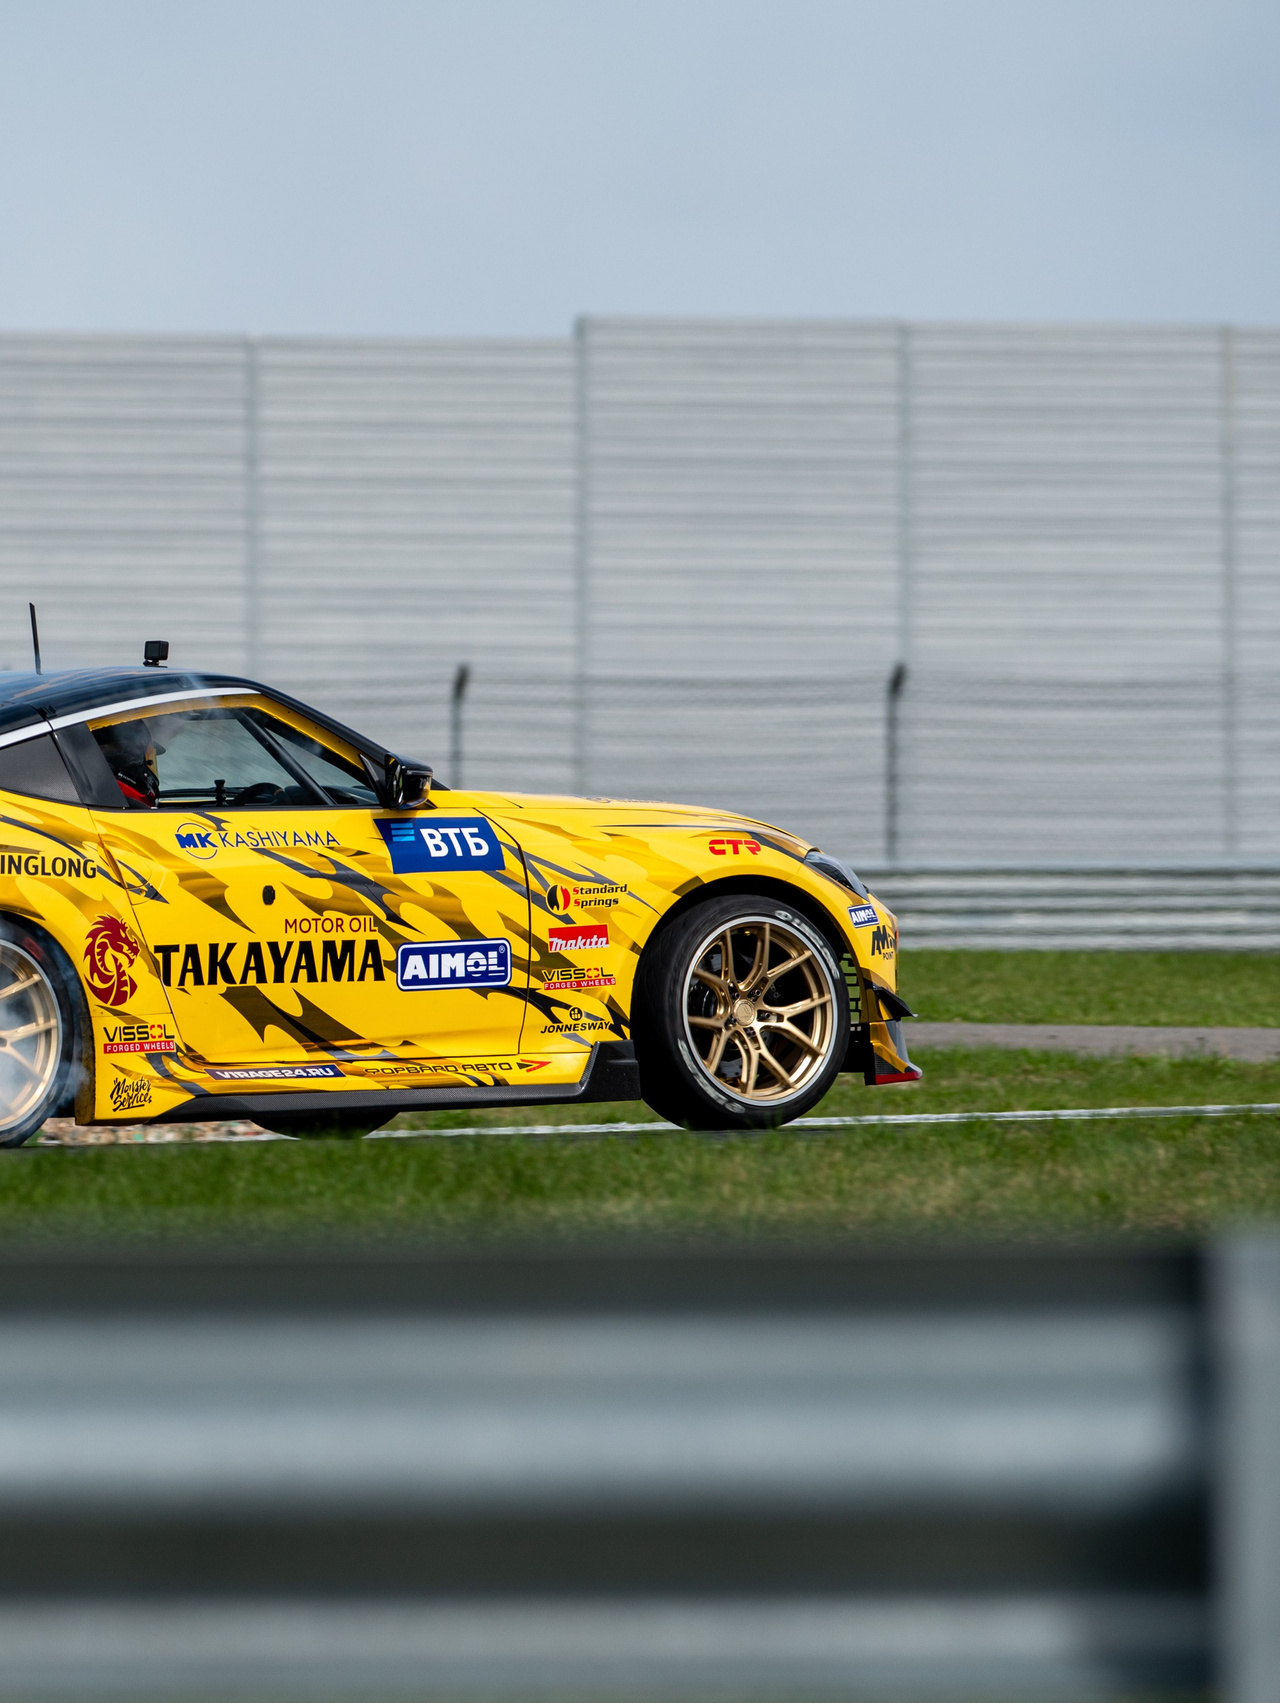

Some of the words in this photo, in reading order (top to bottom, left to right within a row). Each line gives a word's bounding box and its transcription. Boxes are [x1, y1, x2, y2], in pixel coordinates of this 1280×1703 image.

[175, 832, 218, 849] MK
[218, 830, 341, 848] KASHIYAMA
[420, 828, 489, 857] ВТБ
[708, 839, 761, 856] CTR
[573, 884, 628, 895] Standard
[574, 897, 619, 909] Springs
[285, 918, 345, 934] MOTOR
[349, 917, 377, 933] OIL
[154, 939, 386, 987] TAKAYAMA
[543, 966, 614, 982] VISSOL
[545, 981, 578, 990] FORGED
[581, 978, 616, 987] WHEELS
[103, 1024, 176, 1042] VISSOL
[106, 1043, 141, 1053] FORGED
[143, 1041, 174, 1051] WHEELS
[216, 1067, 335, 1079] VIRAGE24.RU
